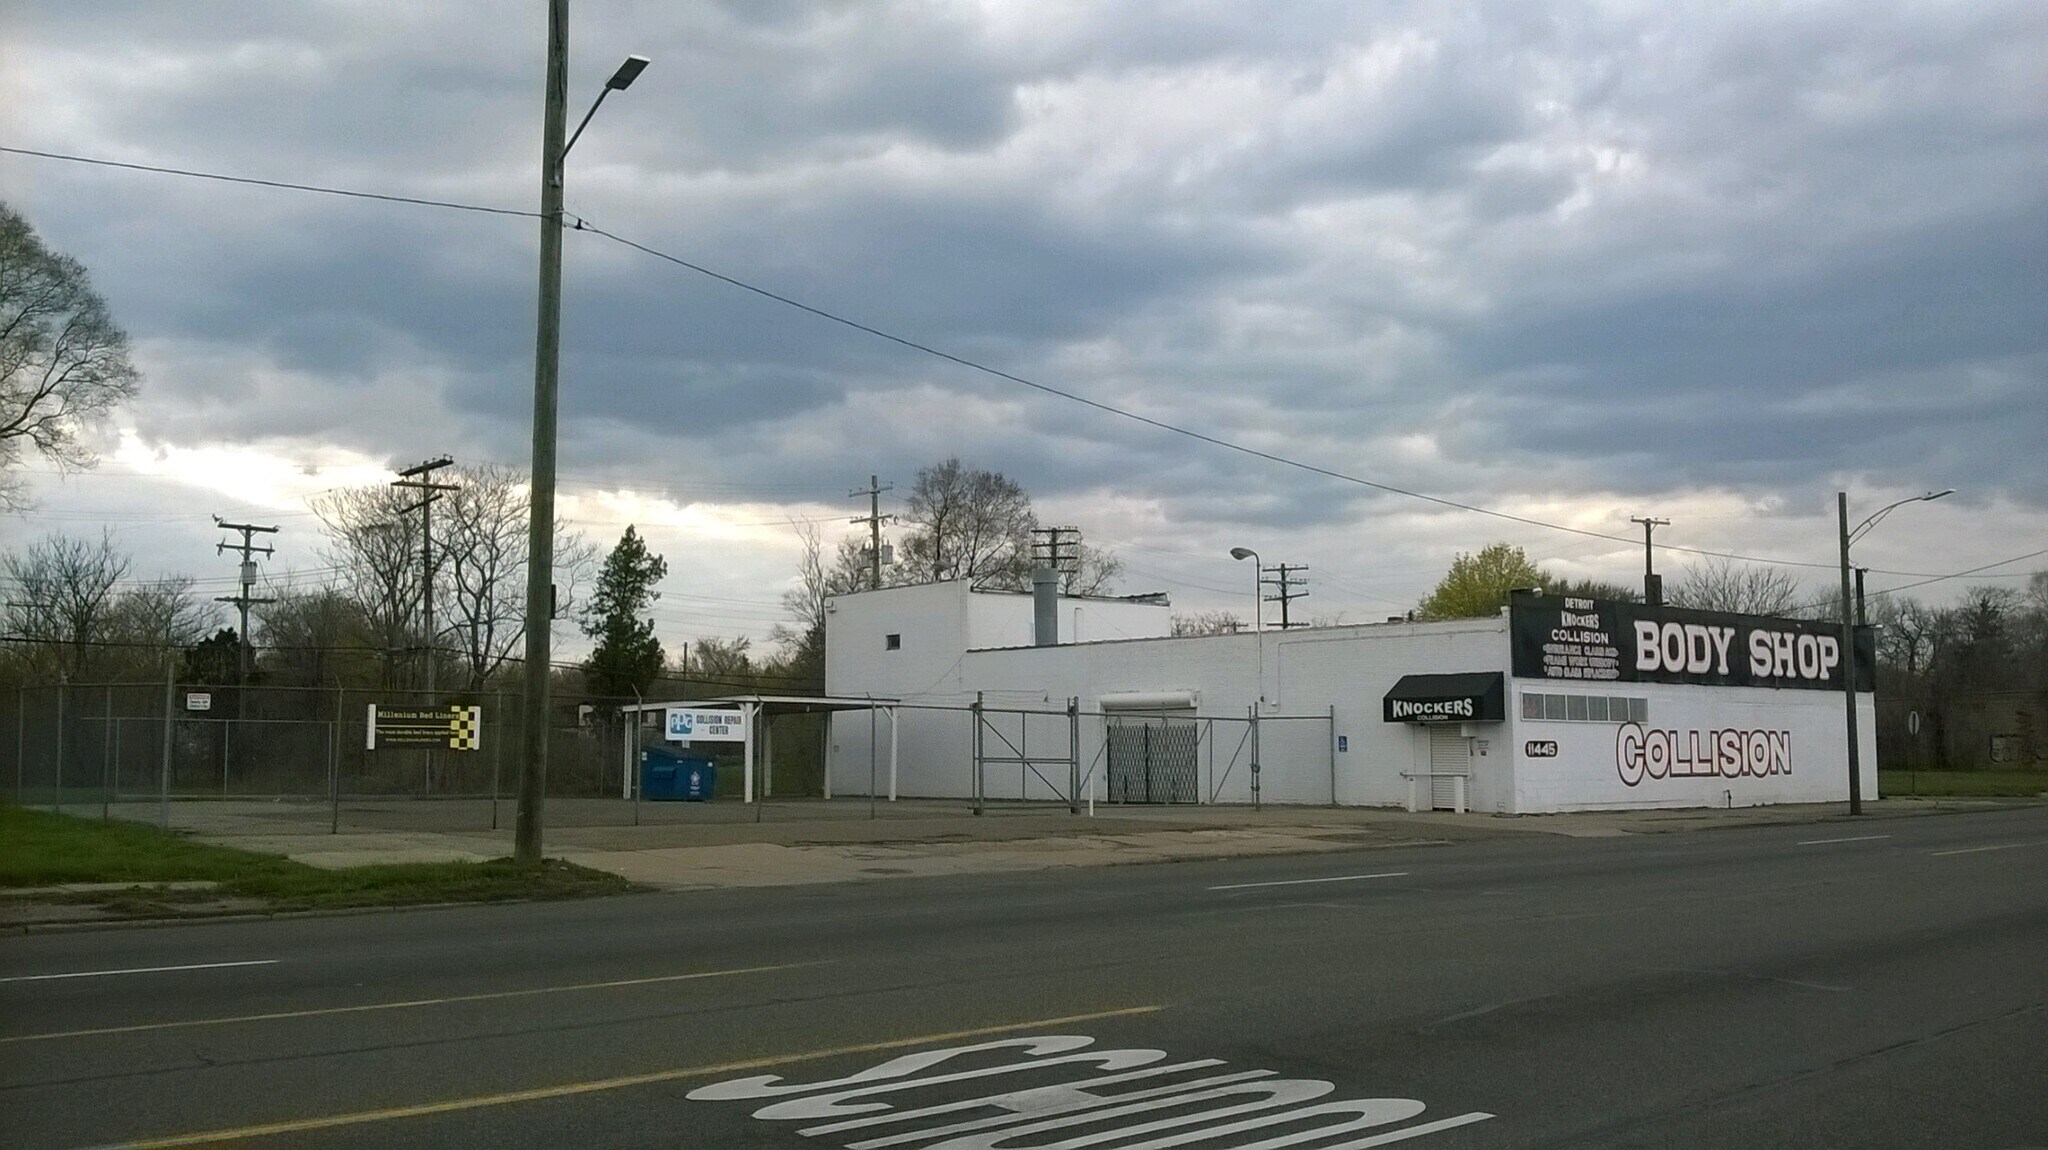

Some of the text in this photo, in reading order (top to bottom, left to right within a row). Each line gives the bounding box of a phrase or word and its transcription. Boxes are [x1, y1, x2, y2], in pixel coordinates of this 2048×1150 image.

[1564, 597, 1594, 610] DETROIT
[1561, 610, 1599, 629] KNOCKERS
[1551, 629, 1609, 645] COLLISION
[1634, 619, 1840, 680] BODY SHOP
[377, 711, 460, 720] Millenium Bed Liners
[1392, 698, 1473, 718] KNOCKERS
[696, 715, 742, 725] COLLISION REPAIR
[709, 725, 729, 735] CENTER
[1527, 742, 1556, 756] 11445
[1616, 721, 1792, 787] COLLISION
